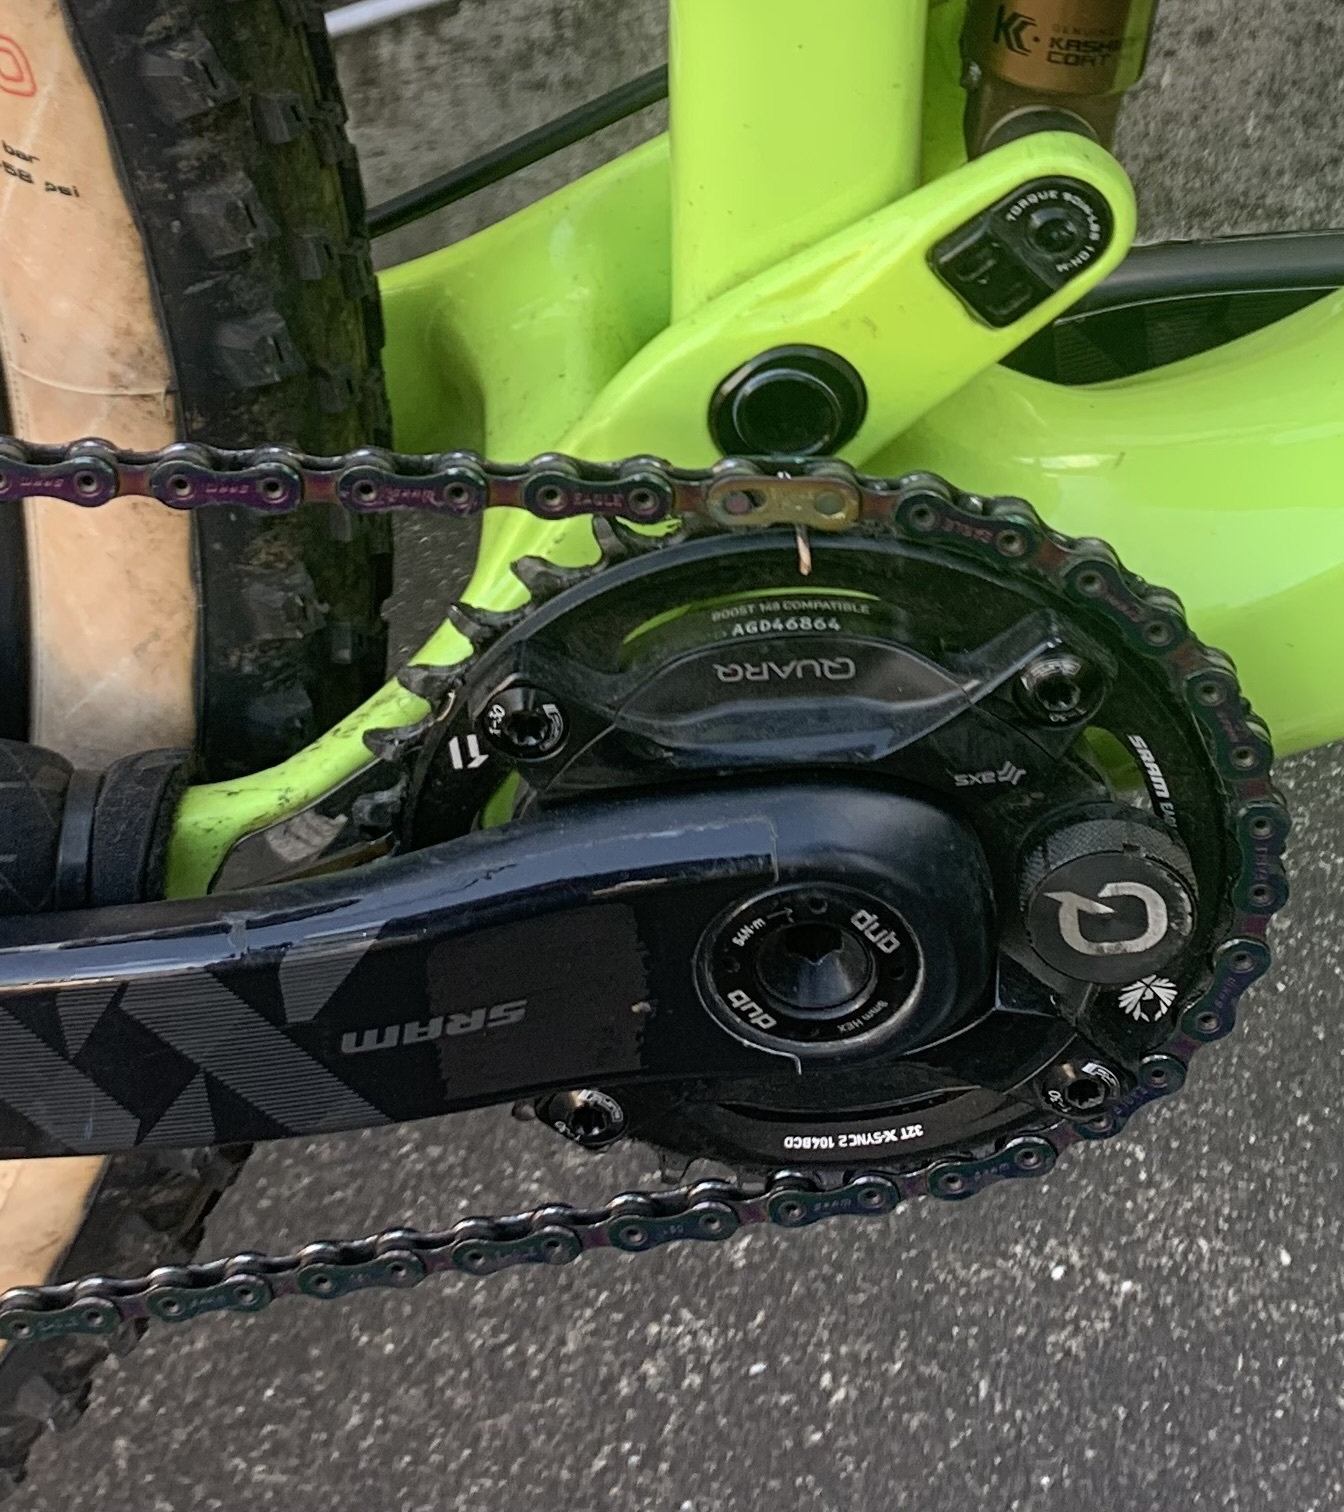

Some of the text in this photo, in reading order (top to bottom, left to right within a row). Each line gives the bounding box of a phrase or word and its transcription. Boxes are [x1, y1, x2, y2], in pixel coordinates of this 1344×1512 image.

[712, 602, 755, 621] BOOST
[782, 599, 871, 616] COMPATIBLE
[712, 657, 856, 683] QUARQ
[1127, 734, 1170, 799] SRAM
[341, 999, 528, 1054] SRAM
[783, 1135, 835, 1149] 104BCD
[900, 1124, 924, 1140] 32T
